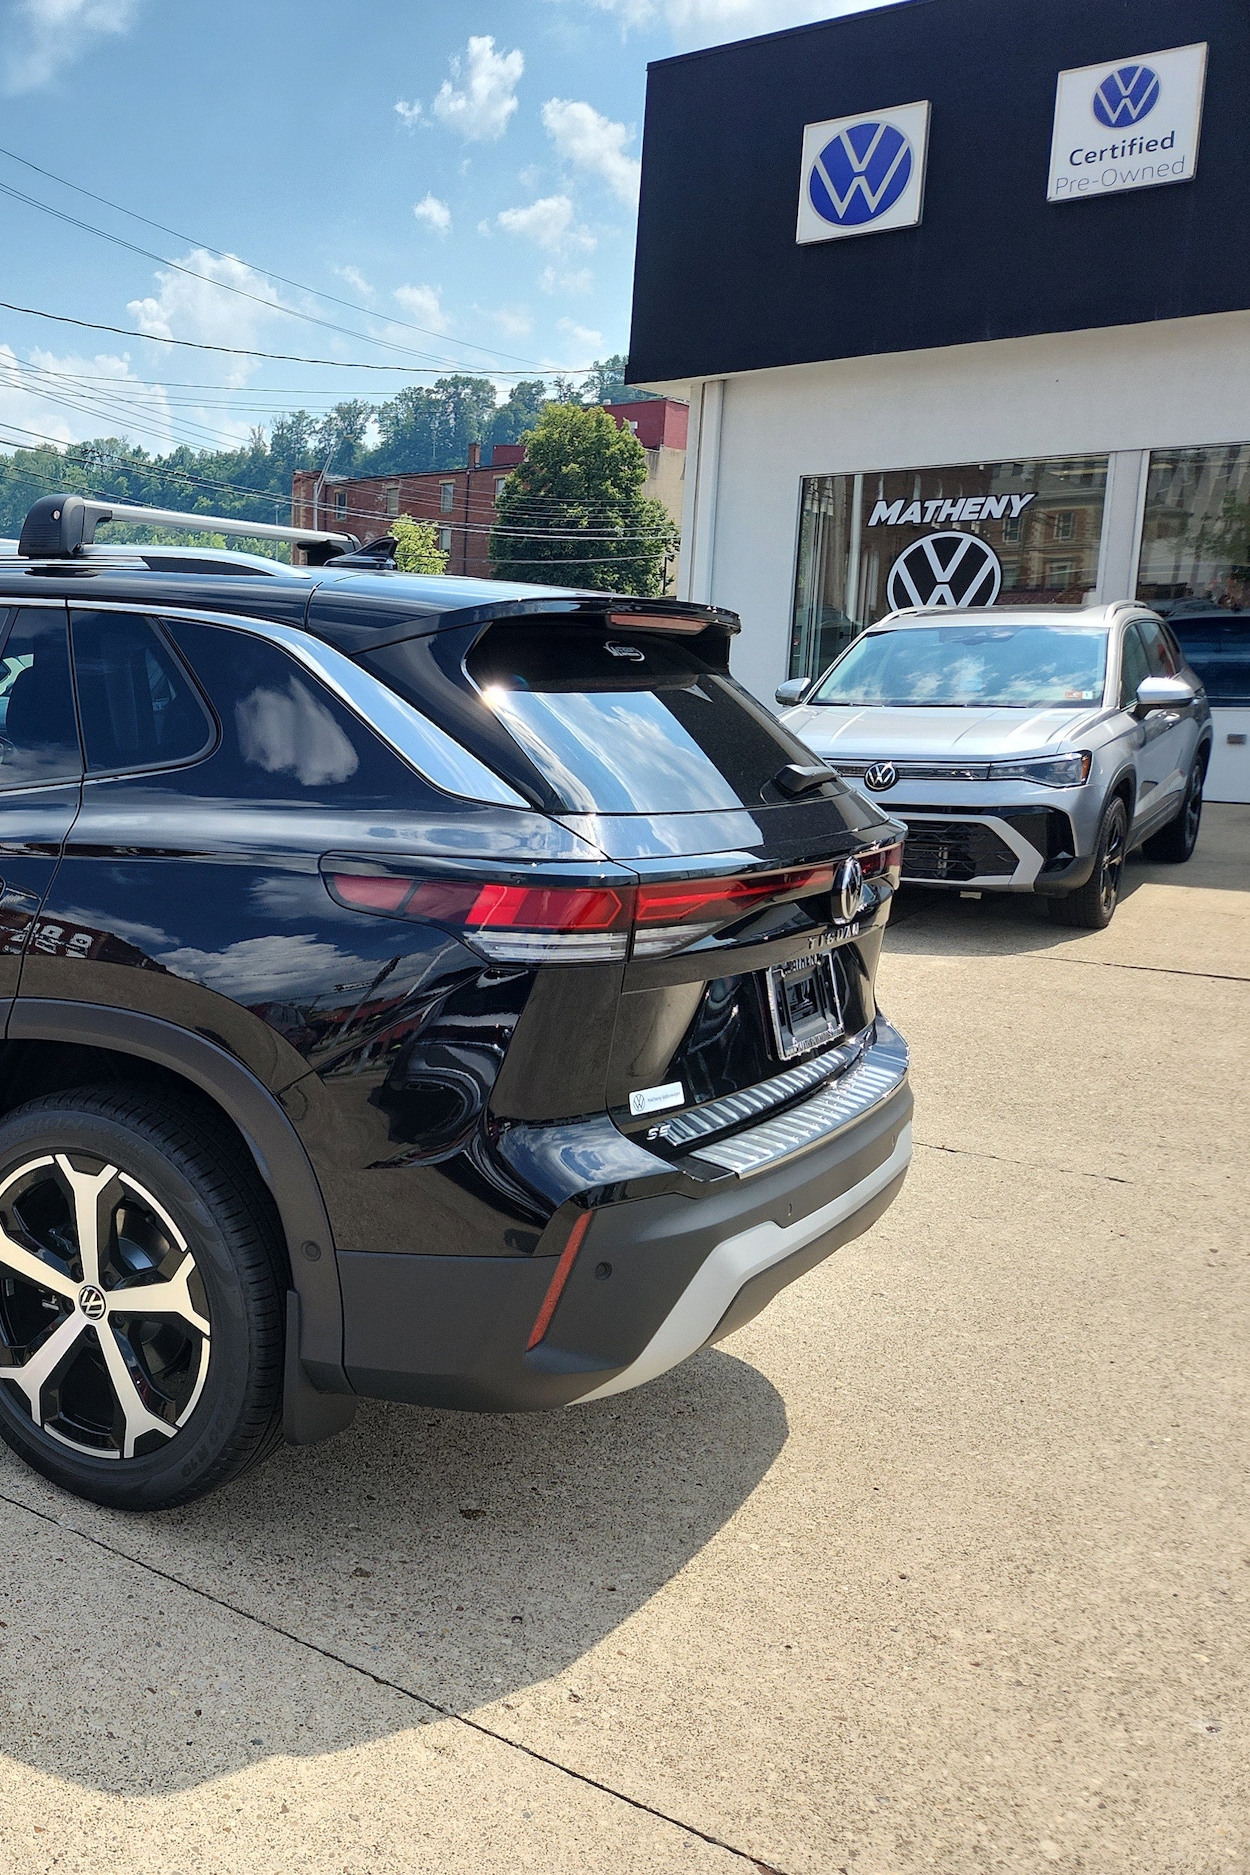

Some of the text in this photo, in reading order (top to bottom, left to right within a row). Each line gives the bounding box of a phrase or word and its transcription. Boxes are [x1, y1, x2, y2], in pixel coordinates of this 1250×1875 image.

[1092, 65, 1161, 129] VW
[1069, 130, 1175, 166] Certified
[807, 120, 915, 228] VW
[1055, 155, 1185, 194] Pre-Owned
[866, 492, 1037, 527] MATHENY
[646, 1124, 671, 1140] SE
